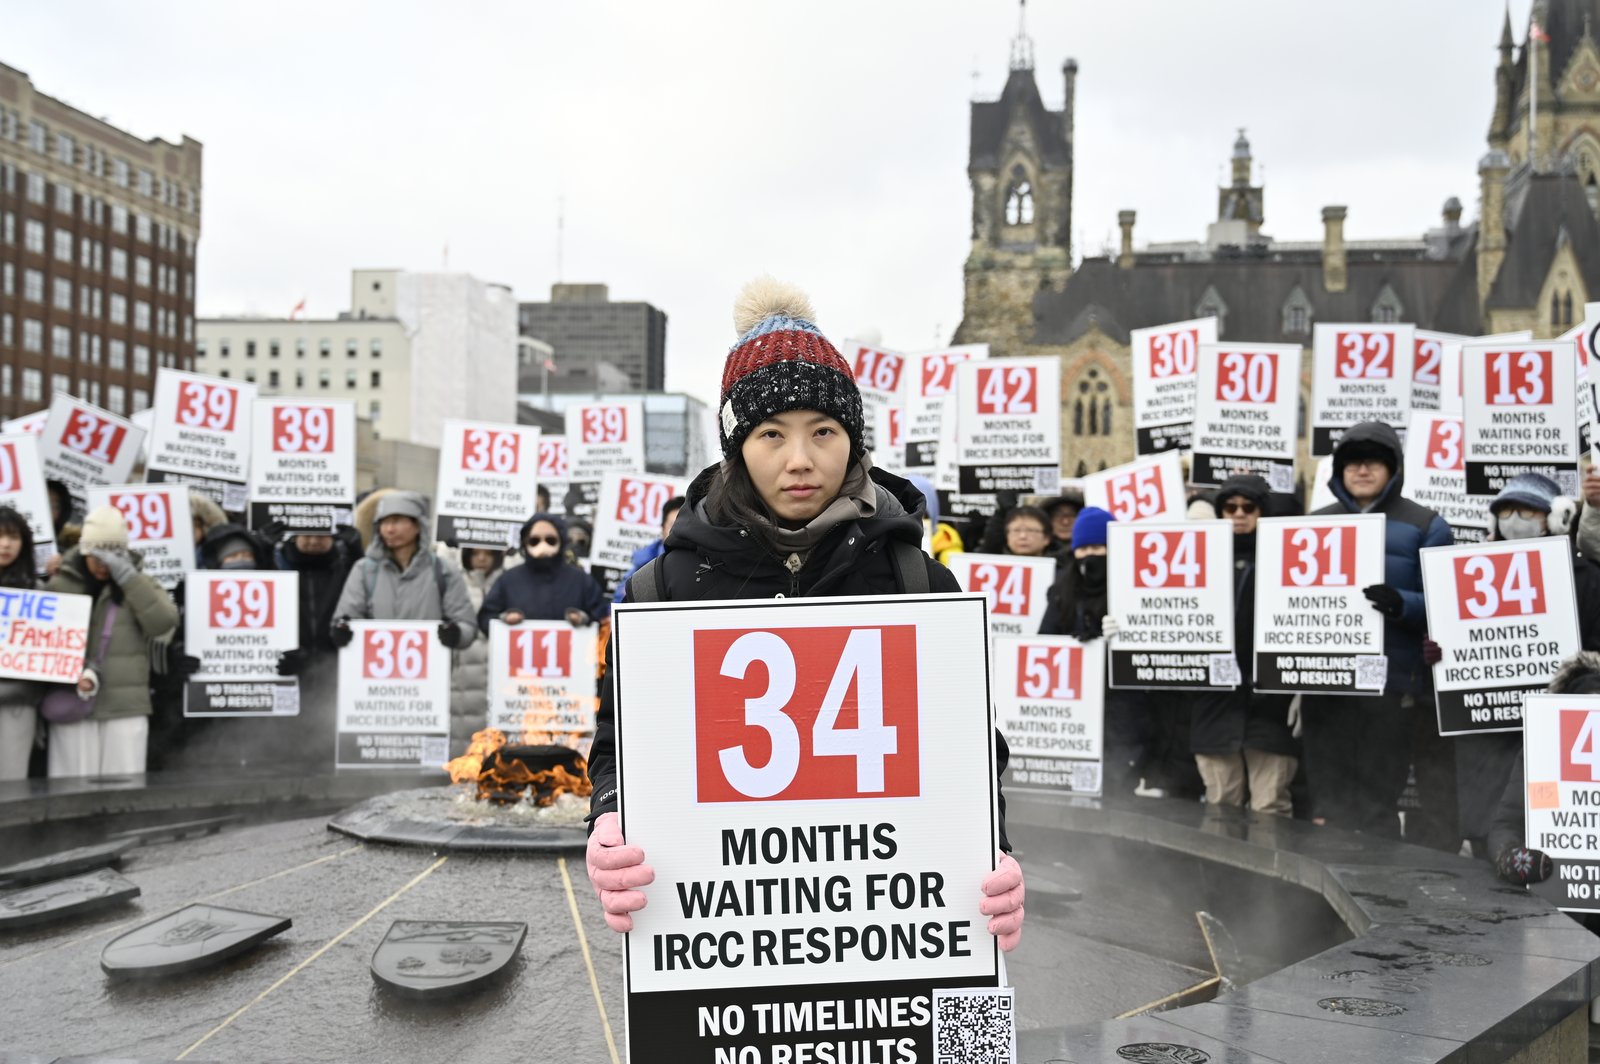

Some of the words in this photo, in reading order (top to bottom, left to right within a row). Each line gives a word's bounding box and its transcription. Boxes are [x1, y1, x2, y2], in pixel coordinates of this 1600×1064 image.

[1153, 332, 1195, 377] 30
[1340, 333, 1389, 378] 32
[1415, 341, 1440, 385] 2
[857, 352, 897, 390] 16
[1221, 353, 1273, 403] 30
[1493, 352, 1544, 405] 13
[982, 367, 1033, 413] 42
[1340, 384, 1386, 394] MONTHS
[1412, 389, 1440, 400] MON
[181, 382, 232, 431] 39
[1327, 398, 1373, 407] WAITING
[1376, 398, 1398, 407] FOR
[1220, 408, 1269, 421] MONTHS
[1492, 413, 1546, 424] MONTHS
[278, 407, 329, 452] 39
[586, 408, 623, 443] 39
[984, 420, 1032, 430] MONTHS
[1208, 423, 1256, 435] WAITING
[1258, 425, 1281, 437] FOR
[67, 413, 117, 461] 31
[178, 431, 226, 446] MONTHS
[971, 435, 1019, 444] WAITING
[1022, 434, 1045, 443] FOR
[1479, 429, 1531, 440] WAITING
[1535, 429, 1561, 440] FOR
[165, 443, 212, 458] WAITING
[215, 450, 237, 461] FOR
[465, 430, 515, 473] 36
[1200, 437, 1224, 447] IRCC
[1226, 438, 1287, 452] RESPONSE
[1432, 421, 1464, 469] 3
[1471, 444, 1498, 455] IRCC
[1501, 444, 1569, 456] RESPONSE
[992, 448, 1051, 458] RESPONSE
[278, 459, 328, 469] MONTHS
[1483, 466, 1500, 476] NO
[265, 472, 314, 482] WAITING
[317, 473, 340, 482] FOR
[465, 477, 511, 488] MONTHS
[1429, 476, 1465, 487] MONT
[285, 486, 345, 496] RESPONSE
[452, 488, 497, 499] WAITING
[501, 491, 522, 501] FOR
[1112, 468, 1160, 522] 55
[1414, 489, 1465, 503] WAITING
[621, 481, 669, 526] 30
[116, 494, 166, 540] 39
[161, 559, 182, 568] FOR
[1139, 531, 1199, 587] 34
[1289, 527, 1348, 586] 31
[975, 565, 1026, 615] 34
[1463, 551, 1538, 619] 34
[0, 592, 57, 620] THE
[215, 580, 269, 628] 39
[1141, 597, 1199, 609] MONTHS
[1288, 596, 1347, 609] MONTHS
[1127, 614, 1183, 626] WAITING
[1188, 614, 1214, 626] FOR
[1273, 614, 1331, 627] WAITING
[1335, 614, 1363, 627] FOR
[992, 623, 1022, 634] NTHS
[1469, 624, 1539, 642] MONTHS
[215, 635, 268, 645] MONTHS
[1119, 631, 1148, 643] IRCC
[1150, 630, 1223, 643] RESPONSE
[1264, 632, 1294, 645] IRCC
[1296, 632, 1372, 645] RESPONSE
[202, 650, 255, 660] WAITING
[368, 630, 423, 678] 36
[516, 630, 563, 677] 11
[1453, 645, 1522, 663] WAITING
[1526, 641, 1560, 656] FOR
[0, 648, 82, 679] OGETHER
[1132, 654, 1148, 667] NO
[1149, 654, 1209, 667] TIMELINES
[1276, 656, 1293, 669] NO
[1294, 656, 1356, 670] TIMELINES
[1024, 647, 1075, 699] 51
[1137, 668, 1154, 681] NO
[1155, 668, 1206, 681] RESULTS
[1281, 671, 1298, 684] NO
[1300, 671, 1352, 685] RESULTS
[1445, 667, 1481, 682] IRCC
[1483, 661, 1559, 679] RESPONS
[368, 685, 419, 696] MONTHS
[354, 701, 406, 711] WAITING
[409, 701, 432, 711] FOR
[1463, 693, 1483, 707] NO
[718, 627, 898, 799] 34
[1020, 705, 1072, 718] MONTHS
[1471, 708, 1491, 722] NO
[346, 715, 374, 726] IRCC
[375, 716, 439, 726] RESPONSE
[1006, 720, 1057, 734] WAITING
[1061, 722, 1086, 735] FOR
[1026, 736, 1092, 751] RESPONSE
[1570, 711, 1600, 782] 4
[1552, 811, 1600, 828] WAIT
[721, 822, 898, 866] MONTHS
[1540, 833, 1582, 850] IRCC
[1559, 864, 1583, 880] NO
[676, 875, 852, 919] WAITING
[865, 871, 946, 912] FOR
[1567, 883, 1590, 899] NO
[652, 930, 745, 972] IRCC
[752, 919, 972, 967] RESPONSE
[698, 1004, 745, 1037] NO
[752, 995, 932, 1035] TIMELINES
[714, 1043, 760, 1064] NO
[772, 1037, 918, 1064] RESULTS
